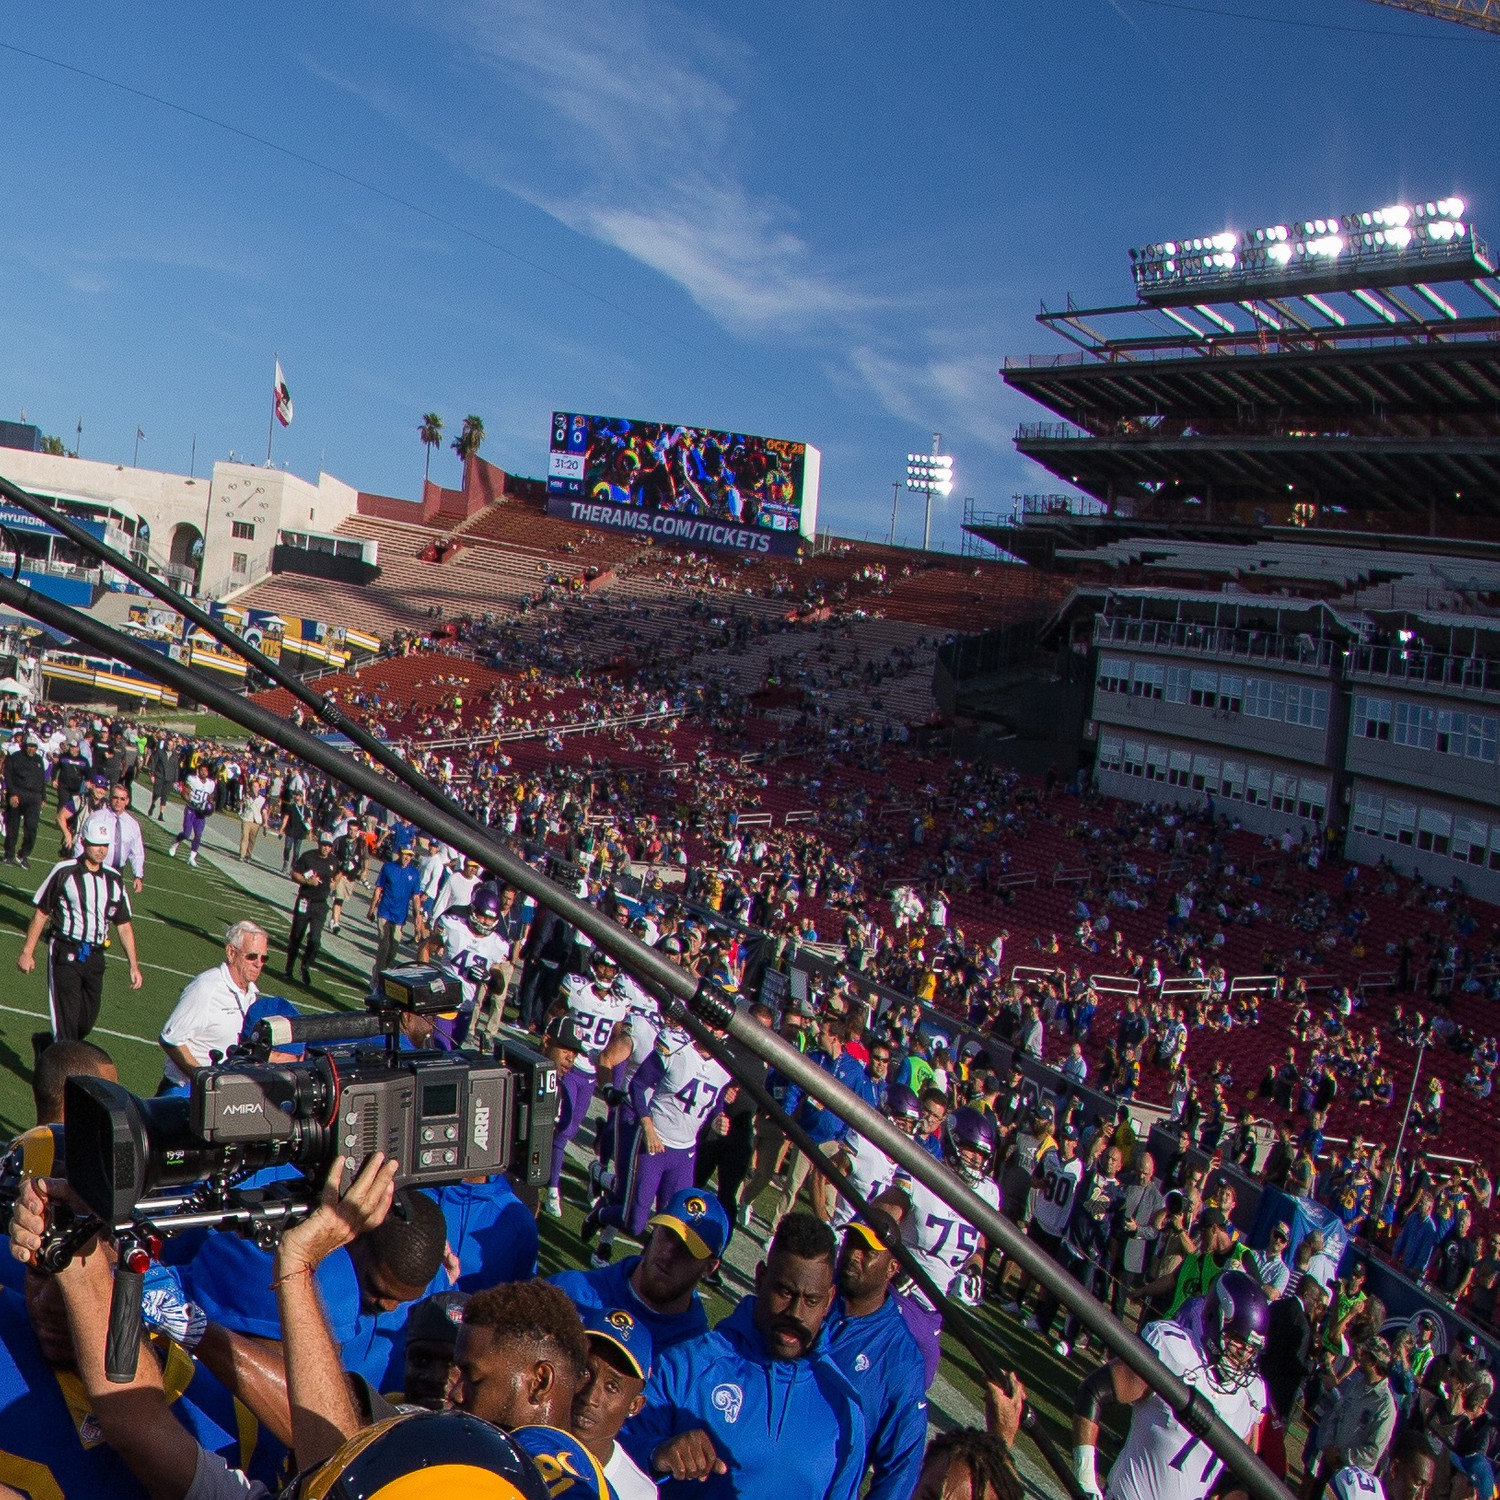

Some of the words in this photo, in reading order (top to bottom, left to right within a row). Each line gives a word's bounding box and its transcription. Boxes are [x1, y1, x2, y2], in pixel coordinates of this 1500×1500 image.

[0, 512, 46, 528] HYUNDAI
[570, 501, 772, 553] THERAMS.COM/TICKETS
[576, 1011, 614, 1048] 26
[222, 1103, 264, 1116] AMIRA
[673, 1078, 720, 1119] 47
[473, 1105, 491, 1152] ARRI
[925, 1212, 980, 1268] 75
